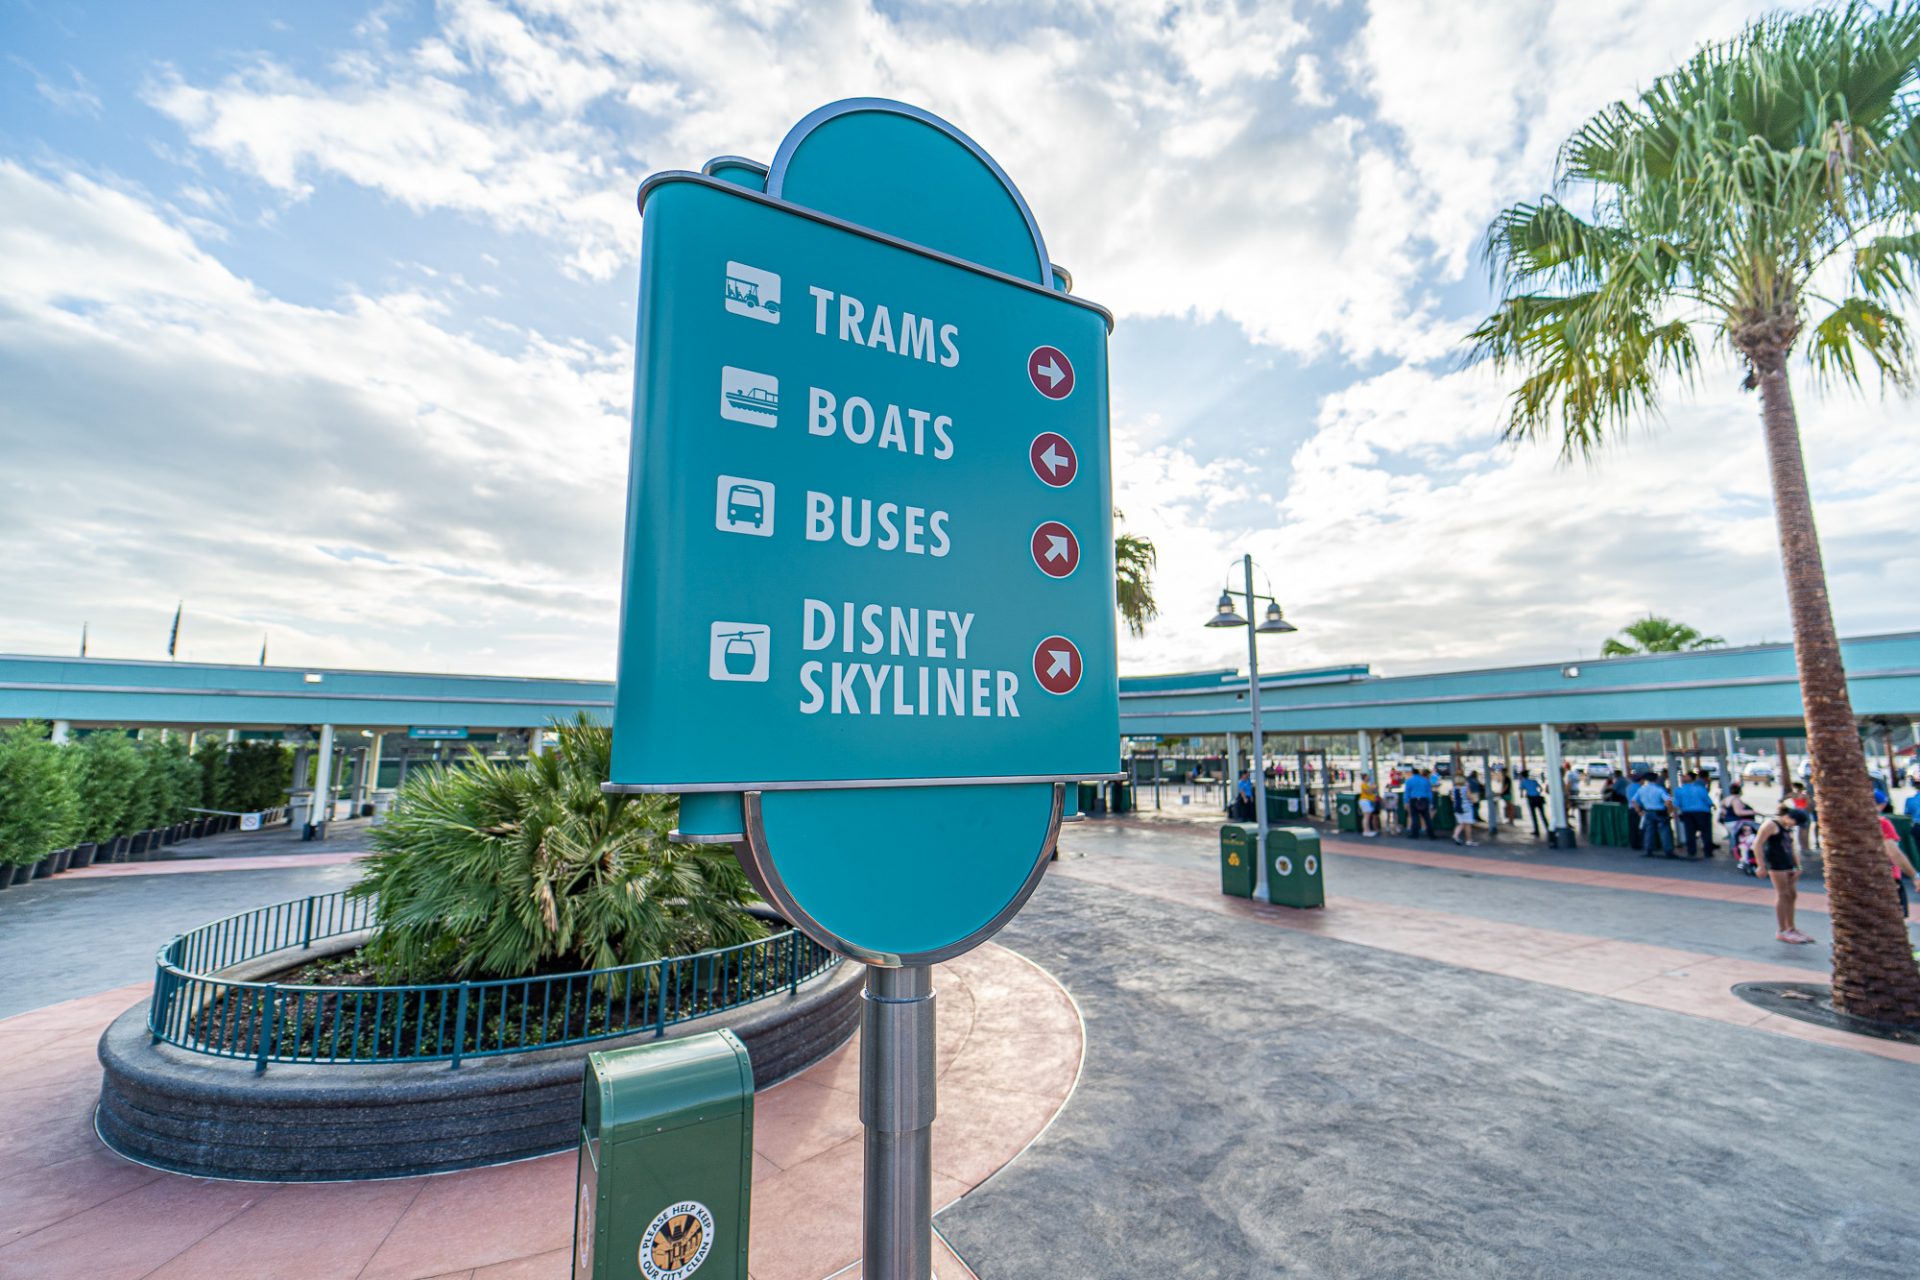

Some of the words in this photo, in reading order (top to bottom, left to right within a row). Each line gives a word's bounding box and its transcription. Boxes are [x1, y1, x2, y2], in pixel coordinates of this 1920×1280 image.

[809, 285, 960, 368] TRAMS
[808, 386, 954, 460] BOATS
[805, 490, 951, 558] BUSES
[802, 598, 975, 660] DISNEY
[799, 660, 1020, 718] SKYLINER
[642, 1212, 669, 1249] PLEASE
[672, 1204, 696, 1215] HELP
[696, 1208, 711, 1228] KEEP
[643, 1260, 660, 1279] OUR
[661, 1270, 683, 1280] CITY
[686, 1241, 709, 1272] CLEAN
